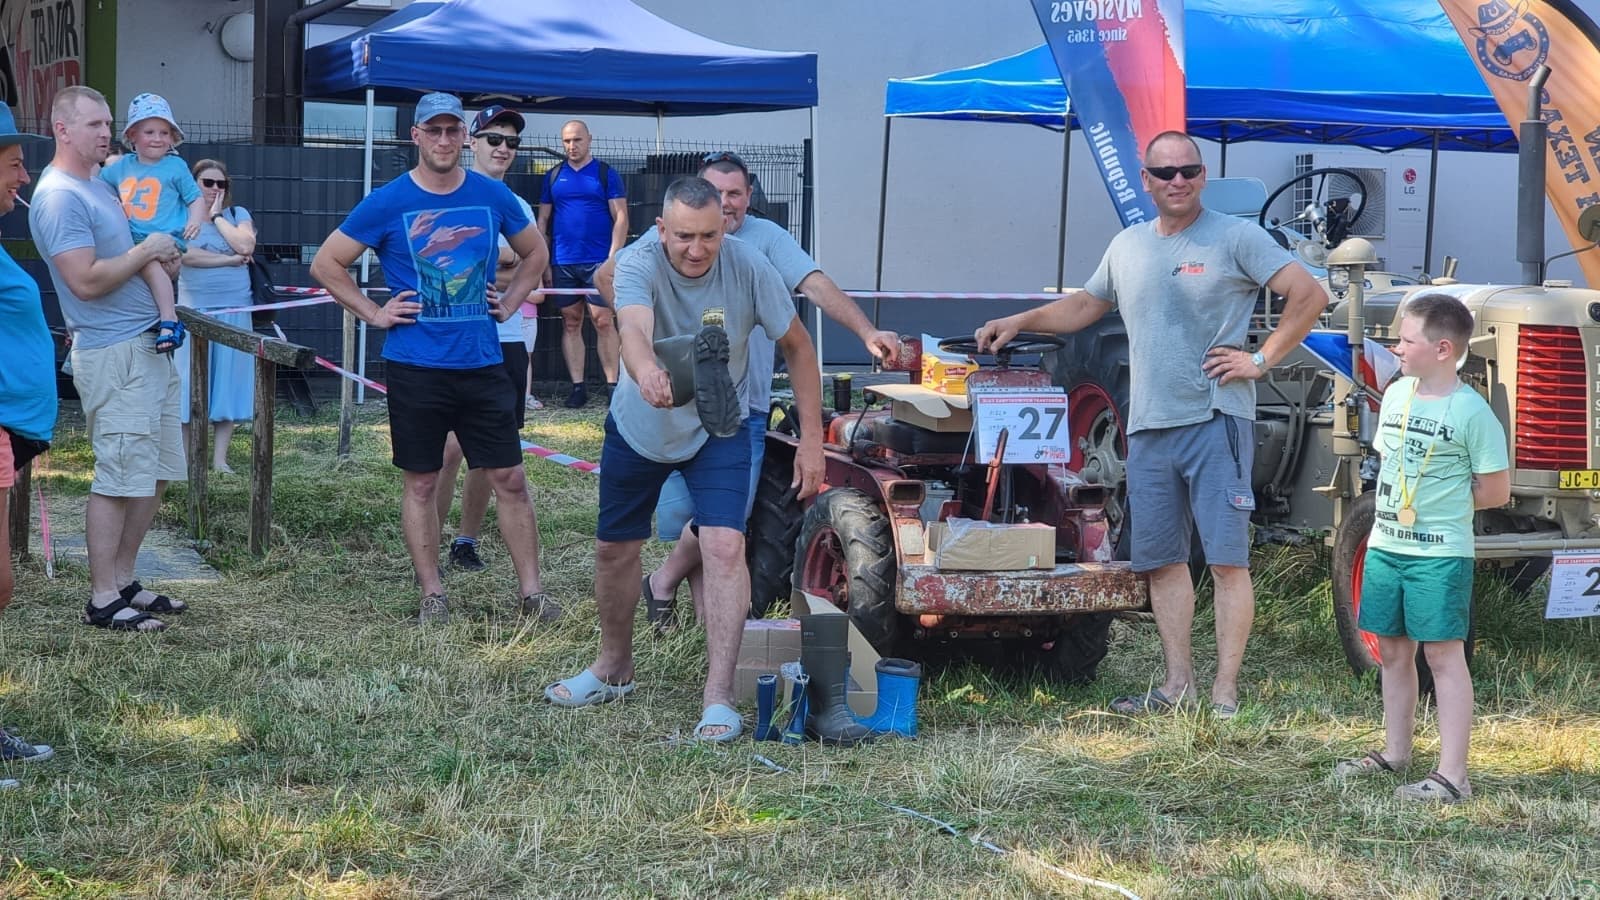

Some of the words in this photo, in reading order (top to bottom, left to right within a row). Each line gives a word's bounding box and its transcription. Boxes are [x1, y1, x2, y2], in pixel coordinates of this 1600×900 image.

[1404, 186, 1415, 194] LG
[1018, 406, 1066, 440] 27
[1565, 472, 1599, 487] JC-0
[1398, 529, 1444, 544] DRAGON
